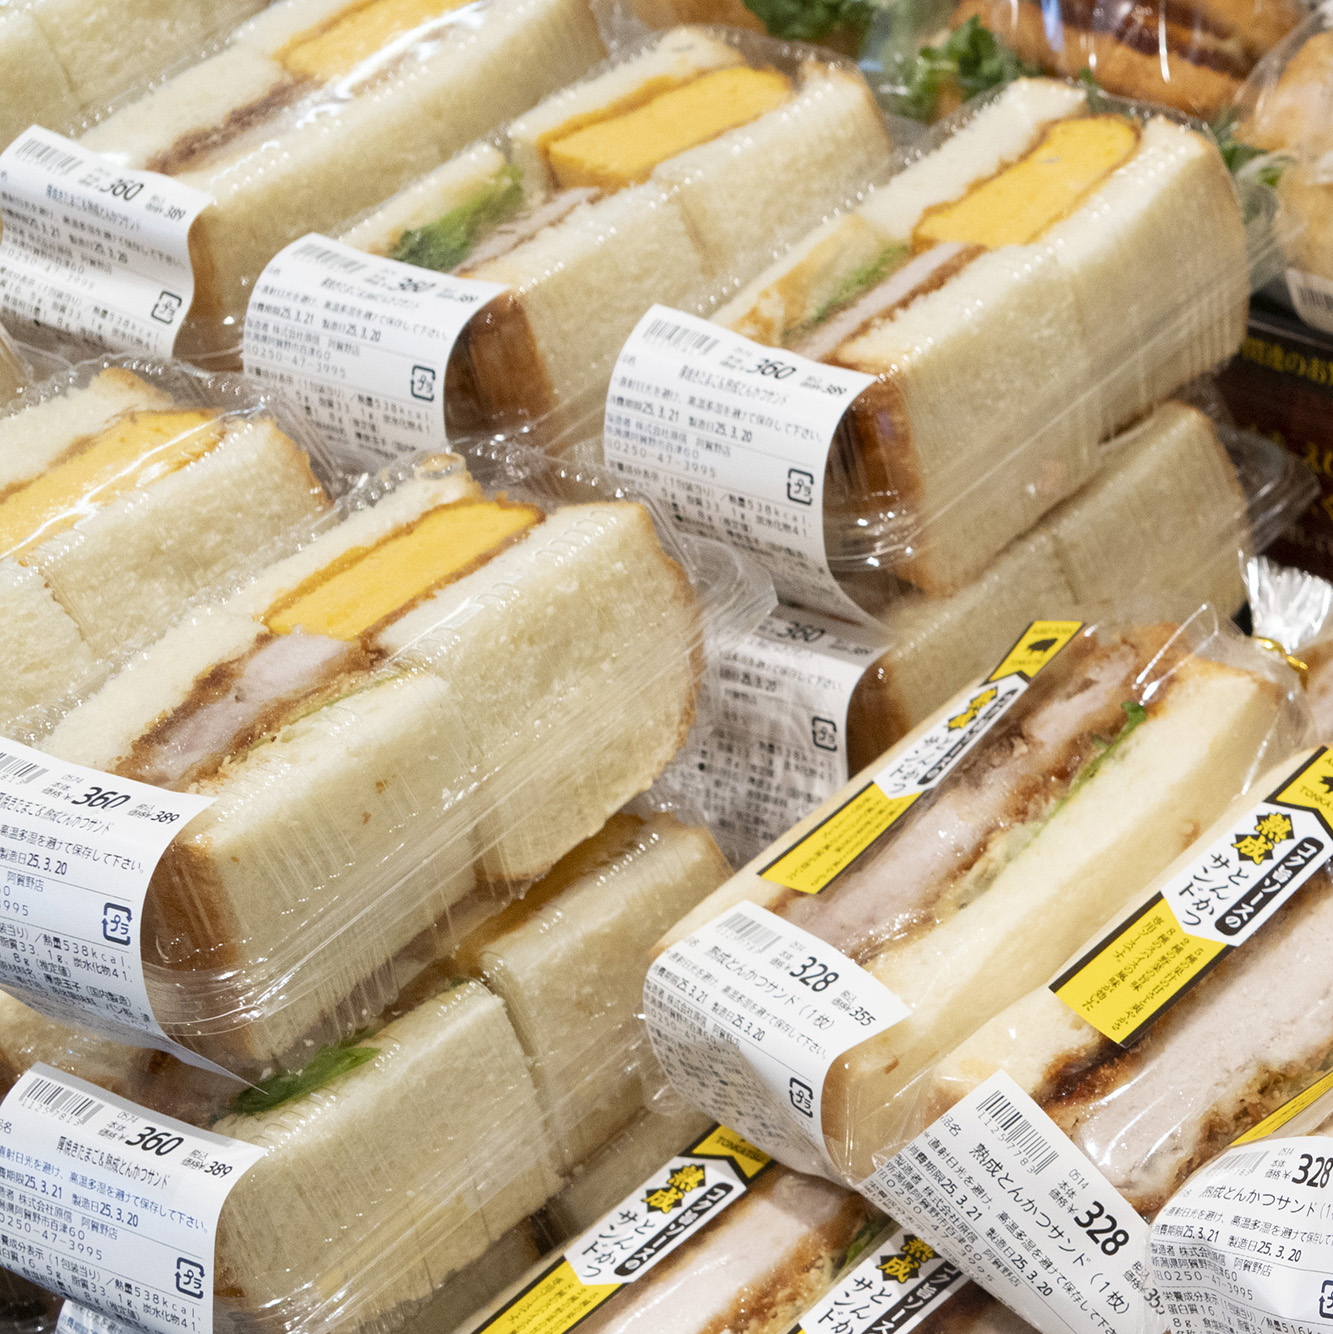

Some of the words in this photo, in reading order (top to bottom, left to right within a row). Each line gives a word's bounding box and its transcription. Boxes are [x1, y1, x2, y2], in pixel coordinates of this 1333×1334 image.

[72, 787, 131, 812] 360
[150, 811, 180, 825] 389
[790, 956, 839, 992] 328
[849, 1006, 876, 1026] 355
[125, 1126, 184, 1156] 360
[204, 1161, 233, 1179] 389
[1074, 1200, 1129, 1256] 328
